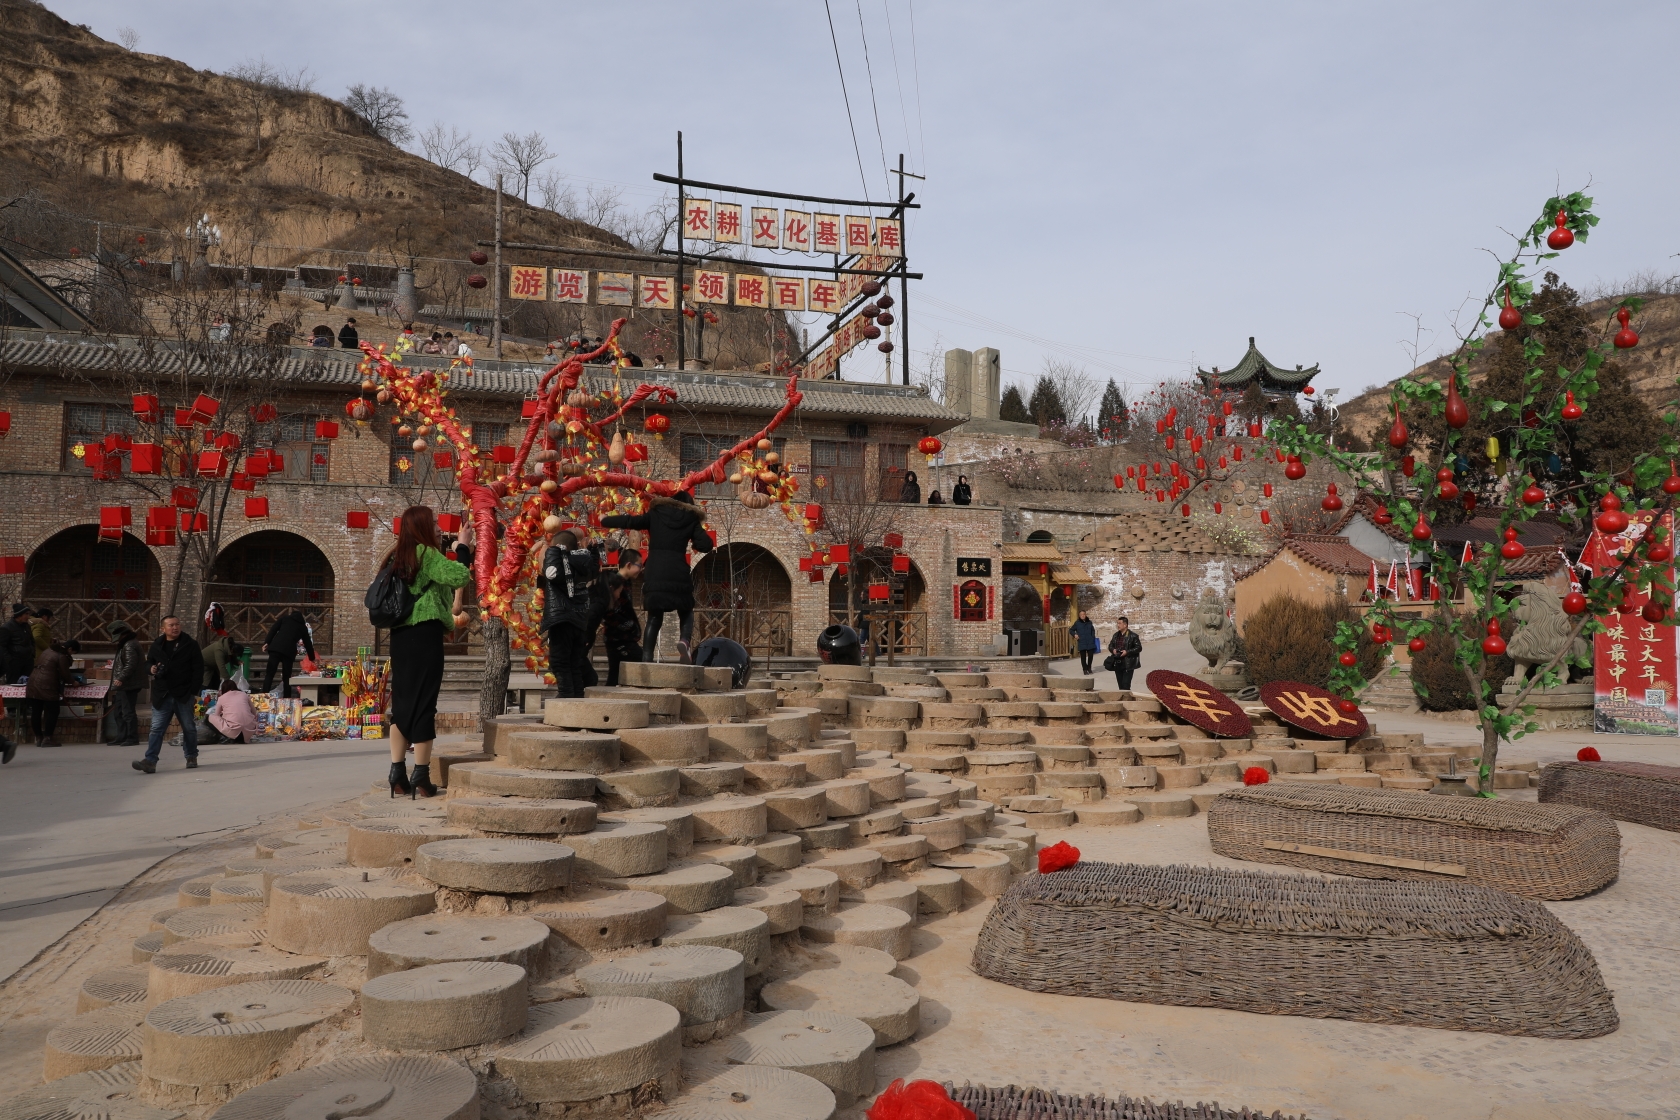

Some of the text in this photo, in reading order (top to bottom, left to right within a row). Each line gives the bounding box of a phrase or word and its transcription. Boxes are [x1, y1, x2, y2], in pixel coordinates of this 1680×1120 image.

[686, 207, 900, 250] 农耕文化基因库
[513, 269, 838, 309] 游览一天领略百年
[961, 561, 987, 573] 售票处
[1275, 690, 1358, 726] 收
